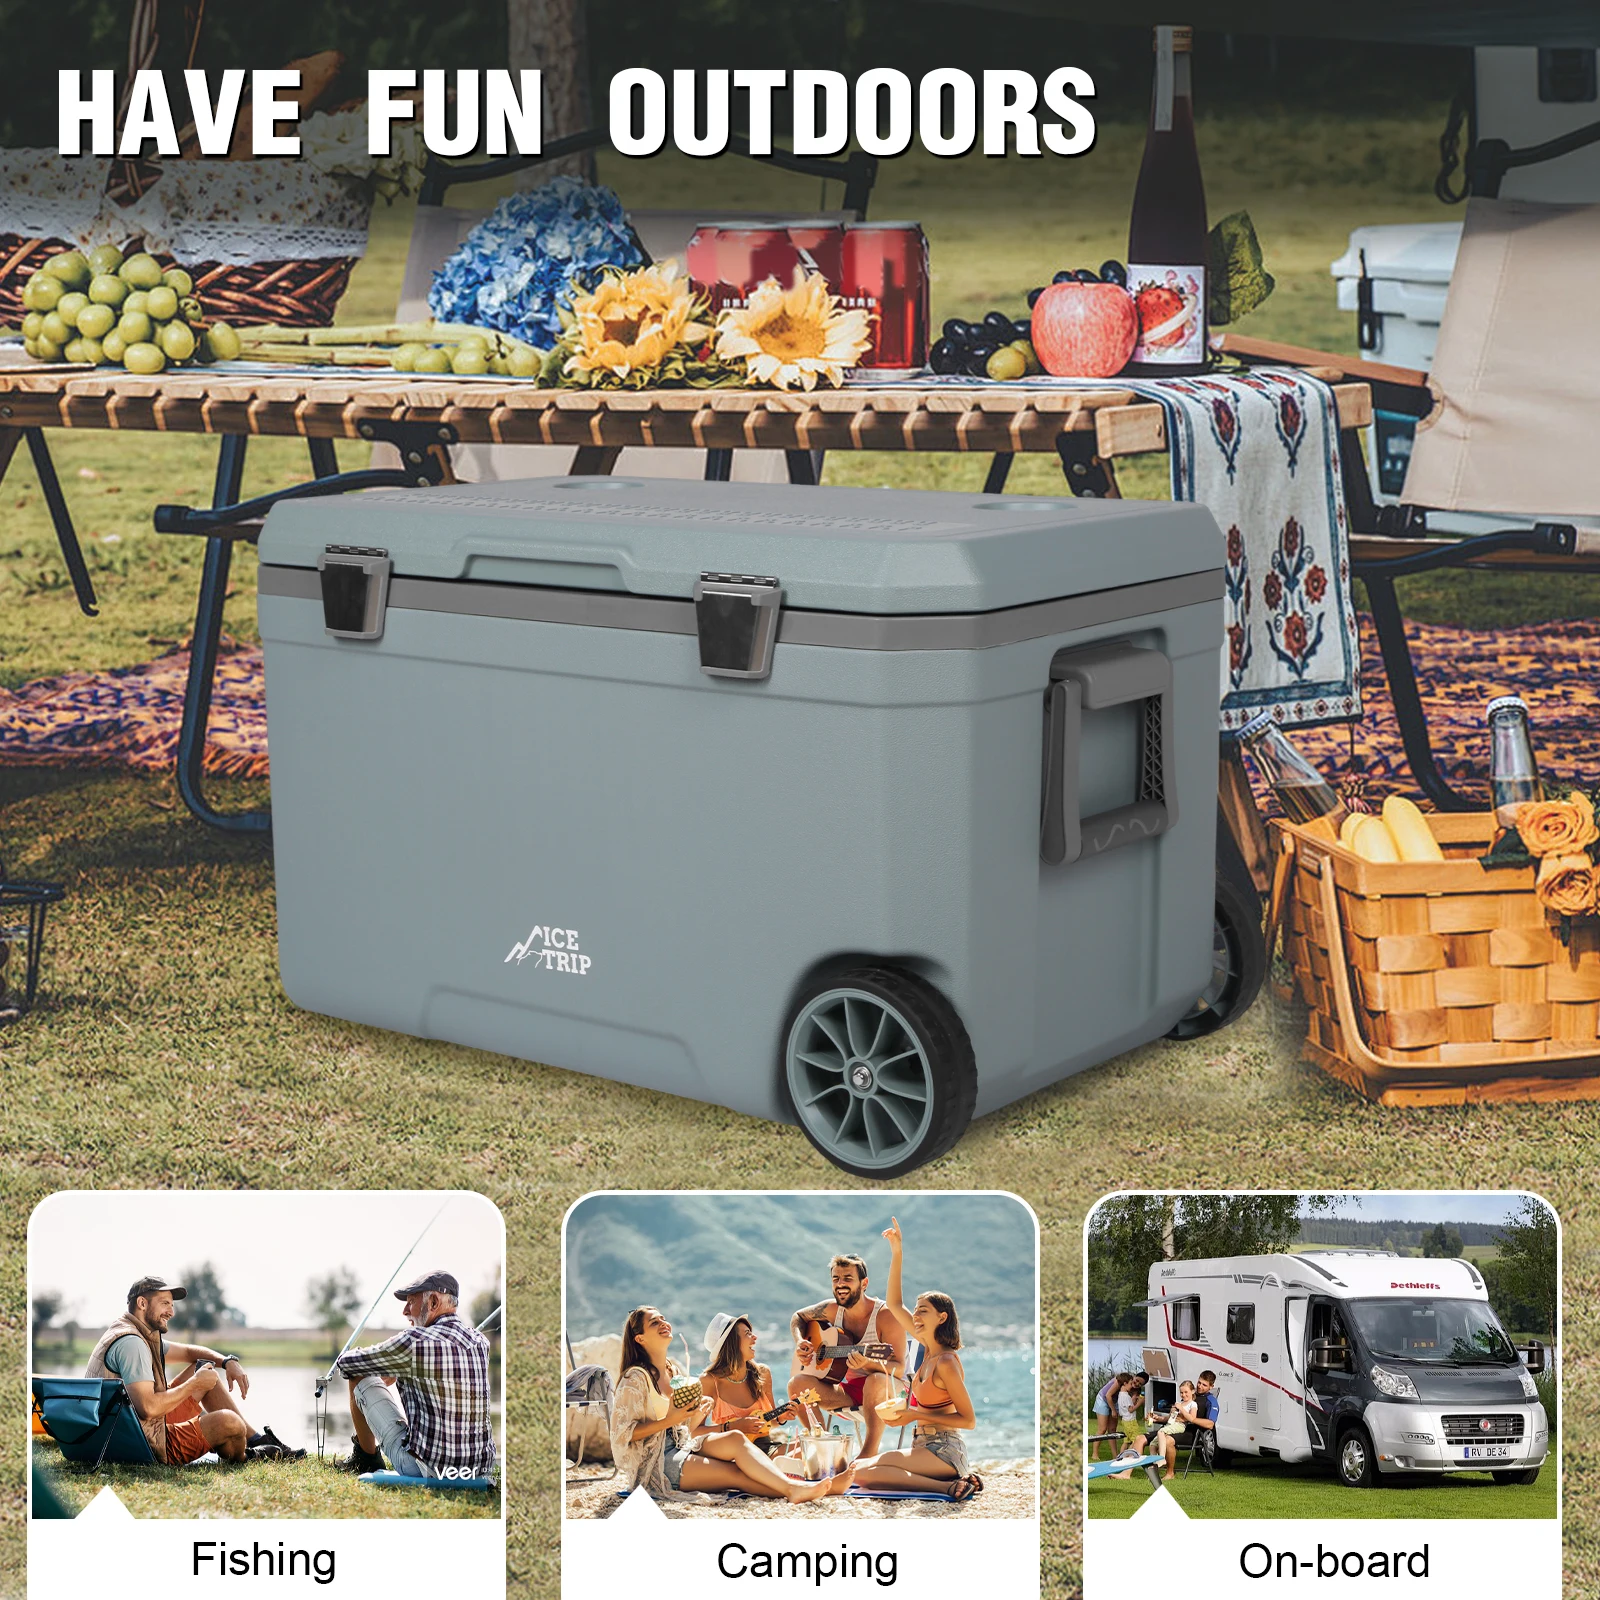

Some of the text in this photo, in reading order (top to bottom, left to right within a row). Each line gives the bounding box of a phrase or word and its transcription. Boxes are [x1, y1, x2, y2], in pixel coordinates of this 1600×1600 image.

[543, 926, 579, 951] ICE
[541, 948, 592, 975] TRIP
[1390, 1282, 1441, 1290] Dethleffs
[1471, 1448, 1482, 1457] RV
